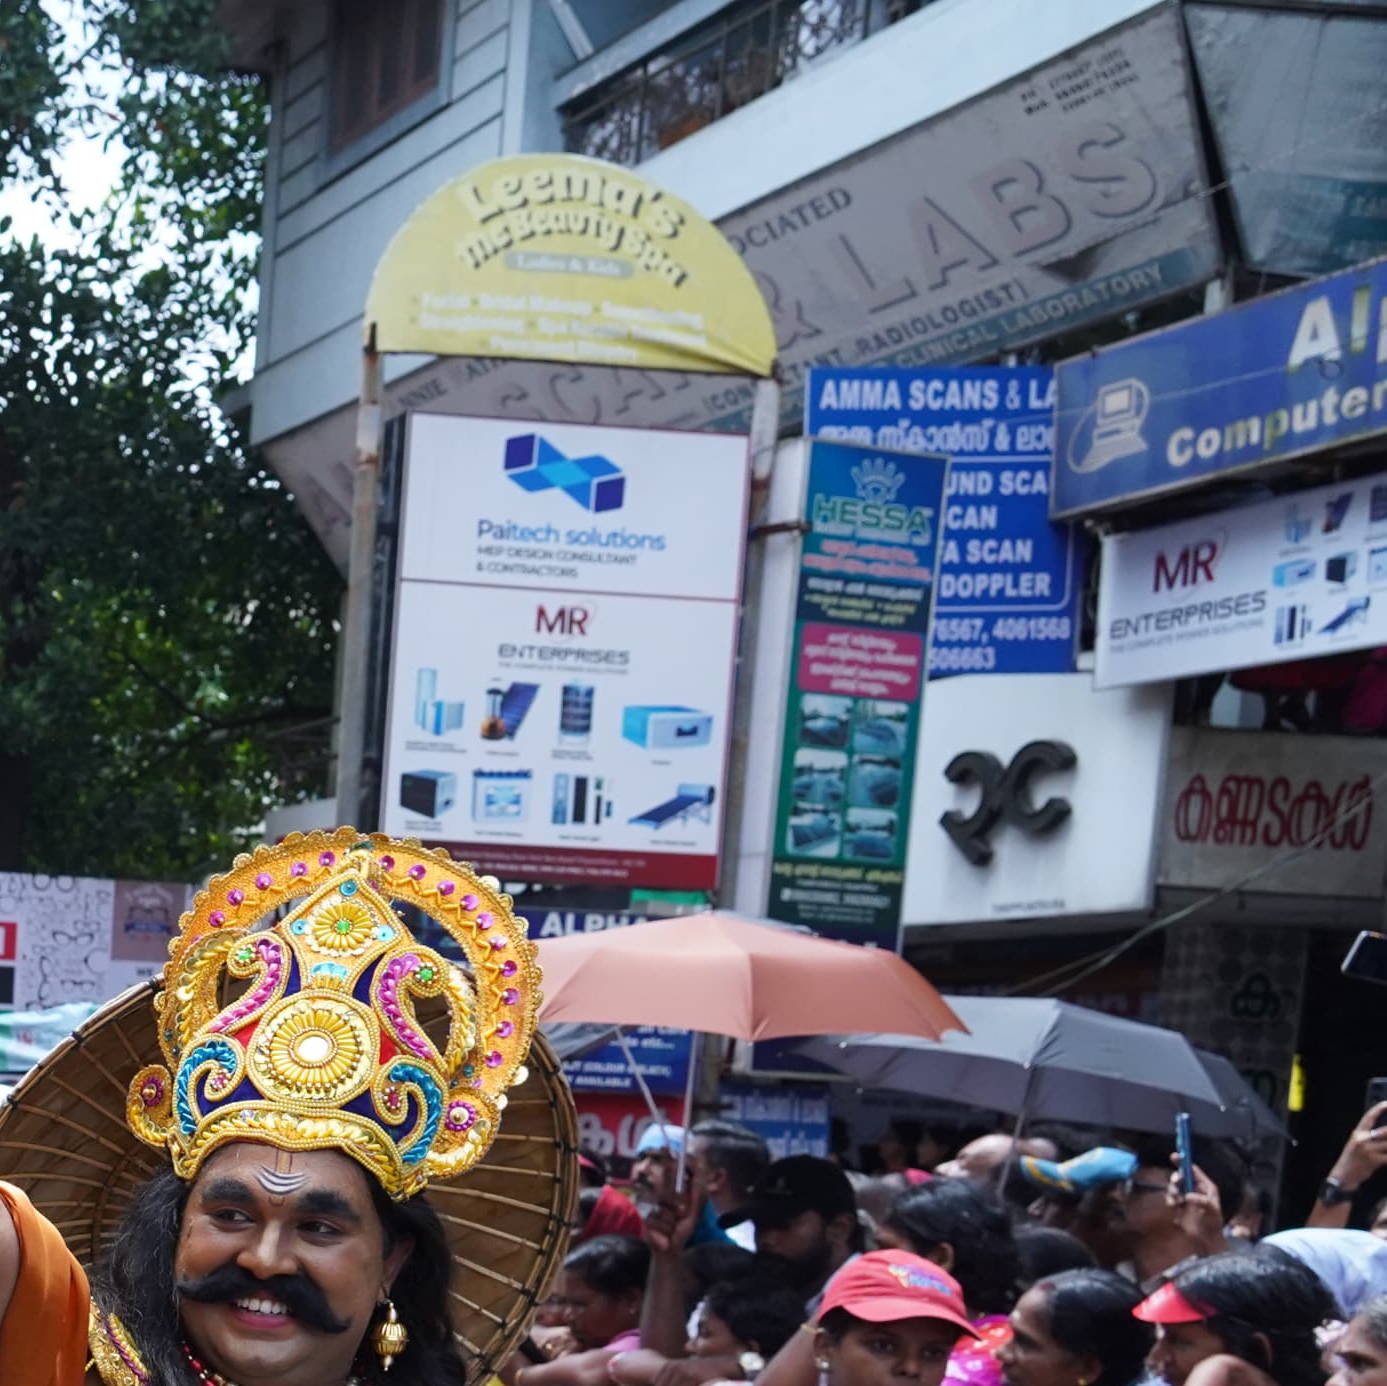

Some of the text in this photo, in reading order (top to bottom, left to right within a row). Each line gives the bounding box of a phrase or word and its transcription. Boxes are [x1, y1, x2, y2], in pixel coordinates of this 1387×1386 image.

[729, 184, 854, 257] OCIATED
[511, 207, 628, 253] Beauty
[622, 230, 689, 289] Spa
[1003, 261, 1164, 341] LABORATORY
[1286, 284, 1387, 374] AI
[818, 379, 1057, 411] AMMA SCANS & LA
[998, 470, 1049, 496] SCA
[813, 492, 934, 535] HESSA
[946, 505, 999, 530] CAN
[565, 526, 668, 551] solutions
[965, 538, 1034, 564] SCAN
[1152, 540, 1219, 594] MR
[938, 571, 1052, 599] DOPPLER
[535, 604, 590, 636] MR
[1109, 589, 1268, 641] ENTERPRISES
[497, 642, 631, 666] ENTERPRISES
[539, 911, 648, 938] ALPH
